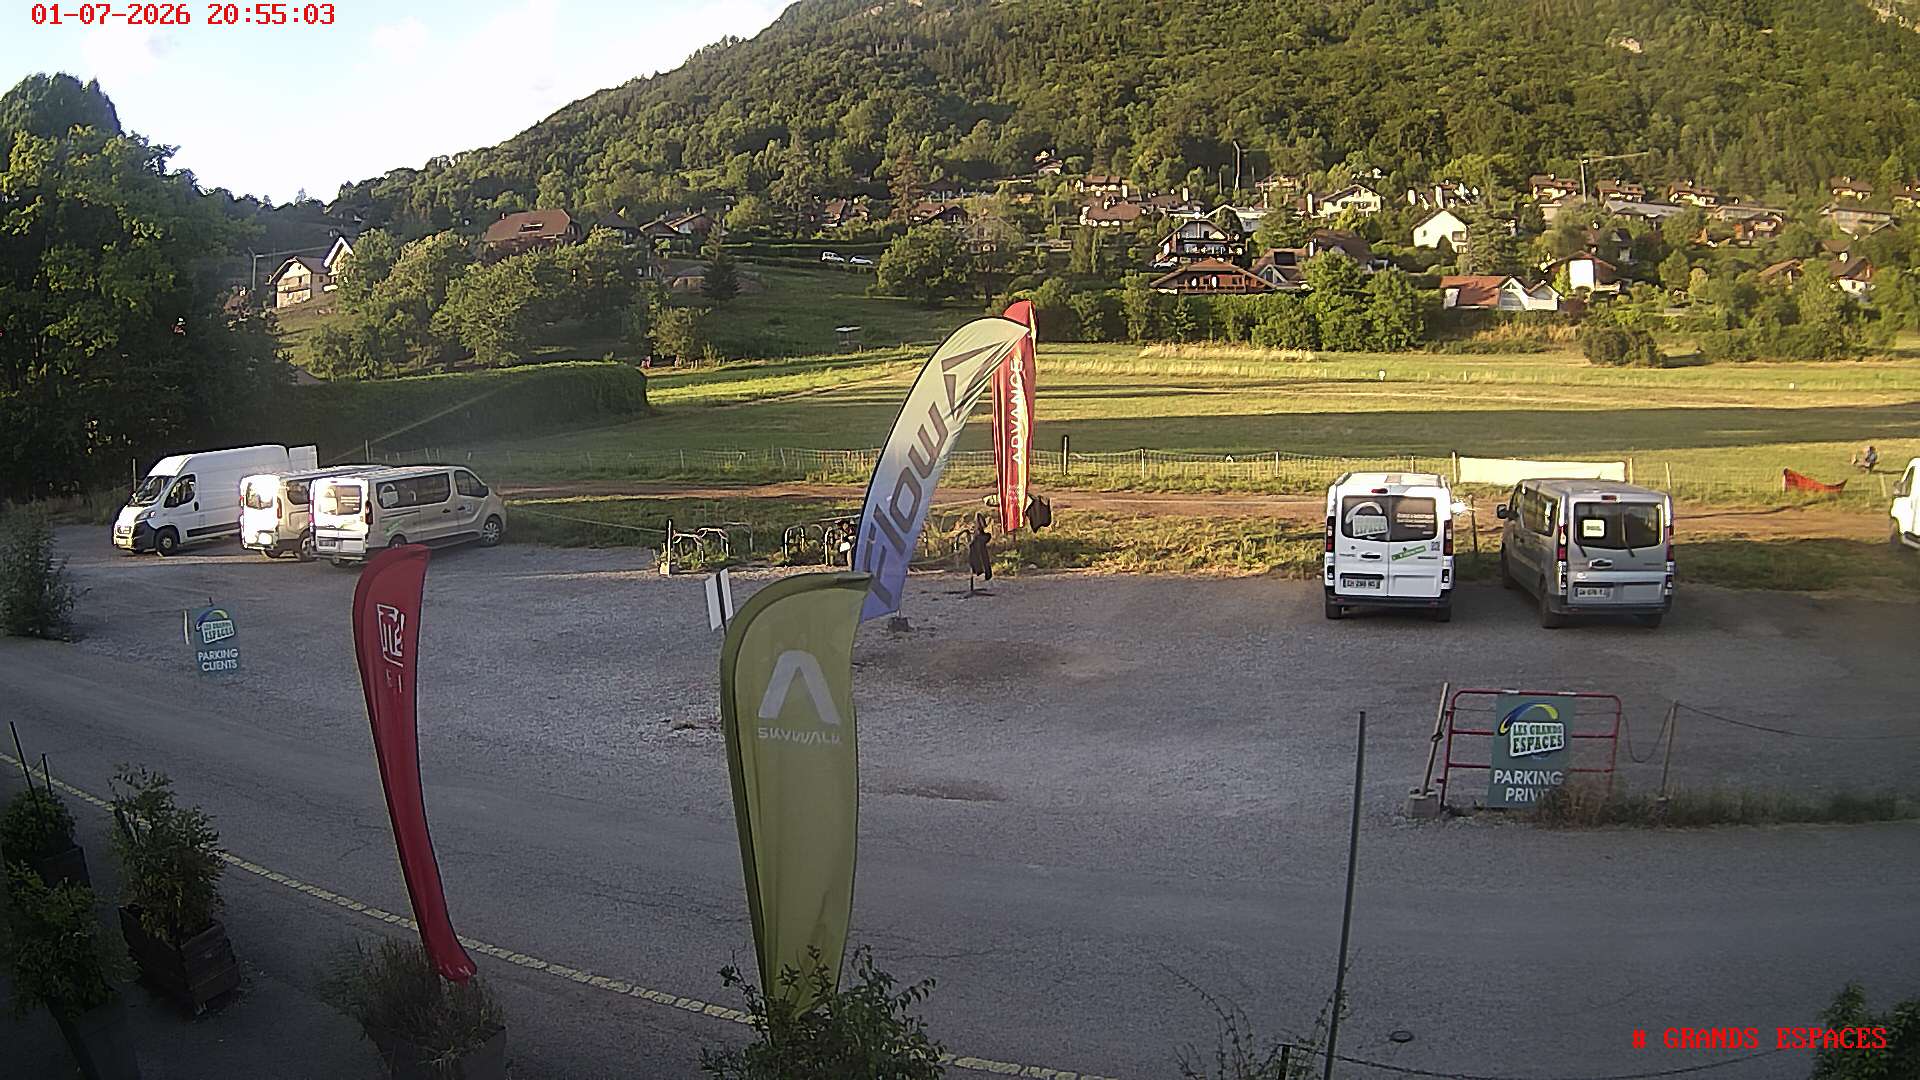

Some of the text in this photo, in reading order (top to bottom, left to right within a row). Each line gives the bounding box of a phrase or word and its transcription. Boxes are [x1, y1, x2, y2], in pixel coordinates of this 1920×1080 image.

[197, 648, 239, 662] PARKING
[201, 659, 238, 672] CLIENTS
[1513, 724, 1527, 735] LES
[1513, 735, 1562, 753] ESPACES
[1493, 769, 1564, 786] PARKING
